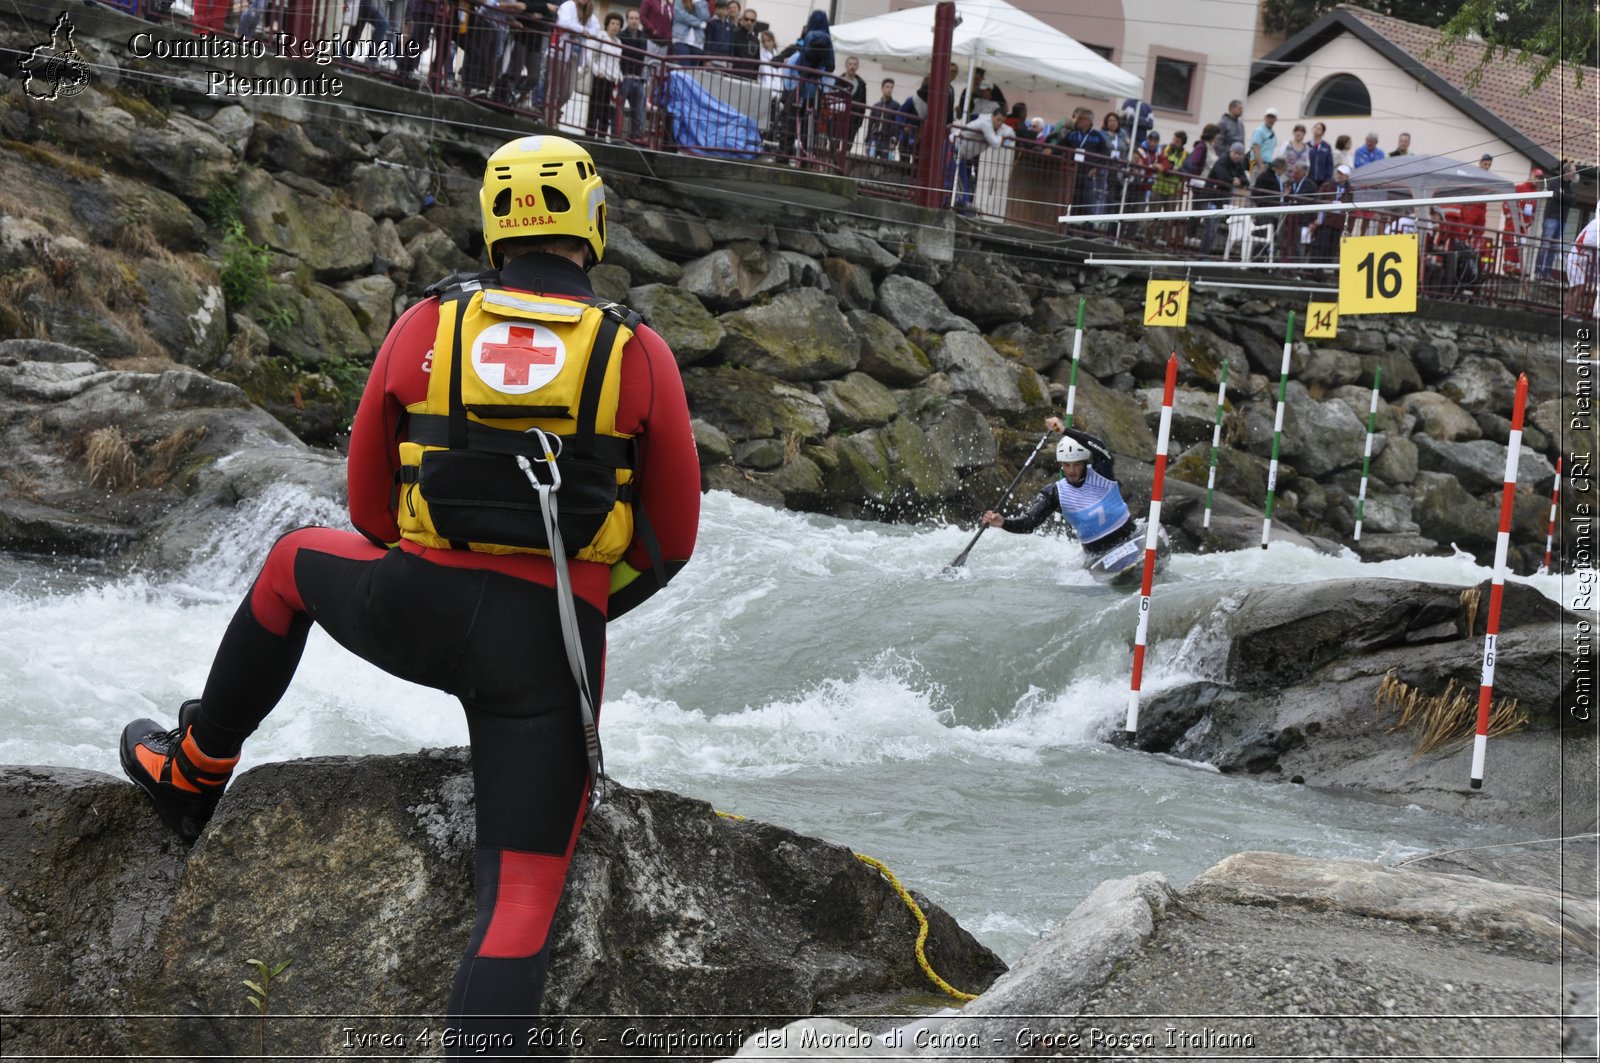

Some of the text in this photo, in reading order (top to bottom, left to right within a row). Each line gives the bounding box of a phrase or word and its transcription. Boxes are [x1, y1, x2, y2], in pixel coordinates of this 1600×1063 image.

[515, 194, 536, 208] 10
[1357, 251, 1403, 299] 16
[1154, 290, 1179, 318] 15
[1312, 309, 1333, 331] 14
[1087, 506, 1107, 526] 7
